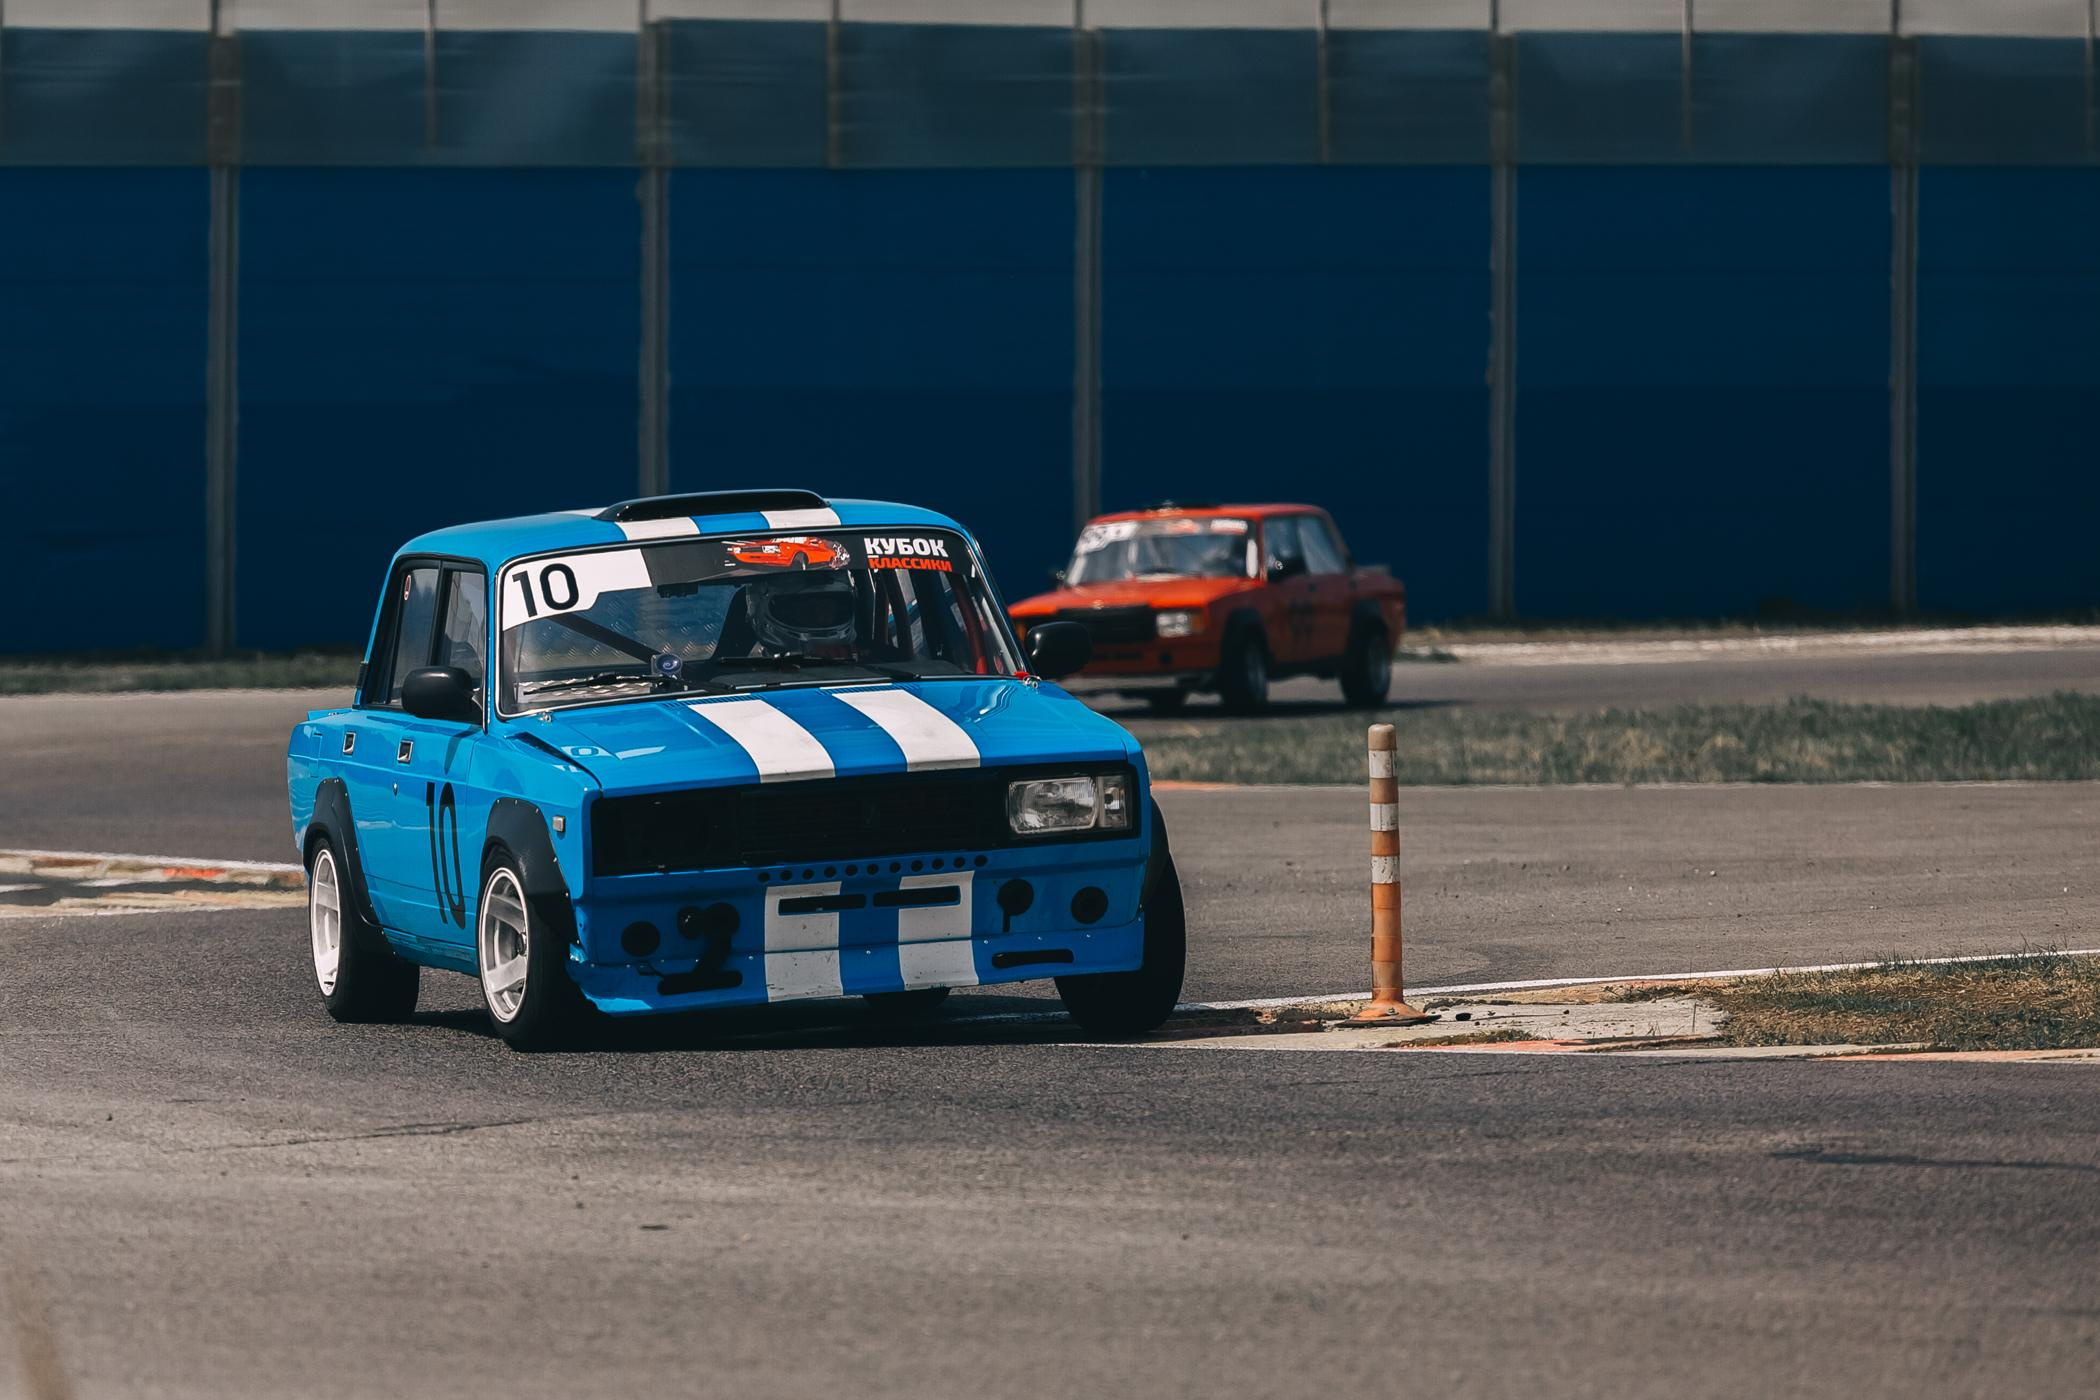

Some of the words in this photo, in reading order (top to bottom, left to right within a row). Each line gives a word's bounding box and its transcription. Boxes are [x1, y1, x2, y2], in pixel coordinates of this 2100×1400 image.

[864, 537, 949, 558] КУБОК
[868, 557, 953, 572] КЛАССИКИ
[512, 563, 579, 618] 10
[425, 781, 466, 930] 10
